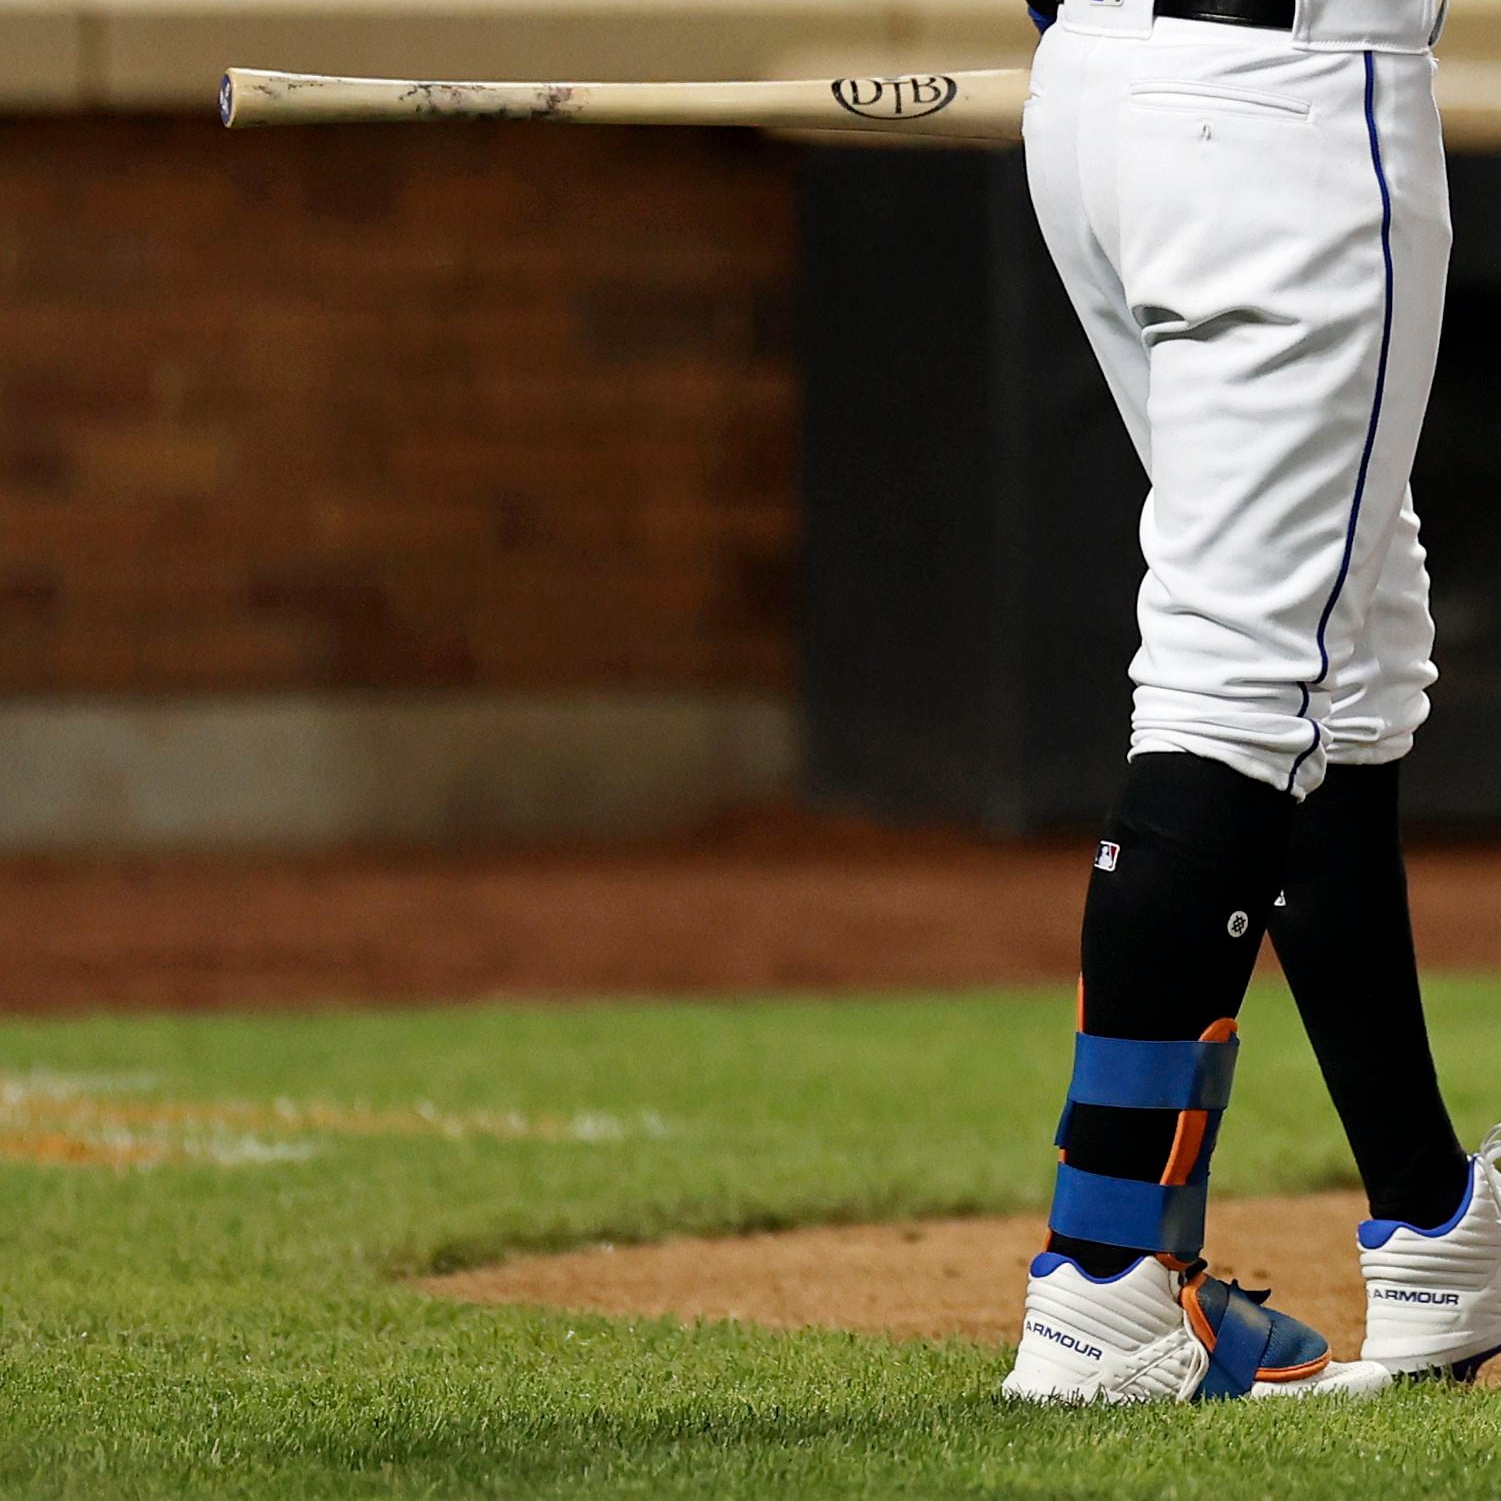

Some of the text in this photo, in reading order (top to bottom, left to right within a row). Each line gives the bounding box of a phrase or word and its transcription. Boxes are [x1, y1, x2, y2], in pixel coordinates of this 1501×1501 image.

[850, 76, 942, 115] DTB
[1373, 1288, 1460, 1306] ARMOUR
[1026, 1320, 1103, 1361] ARMOUR
